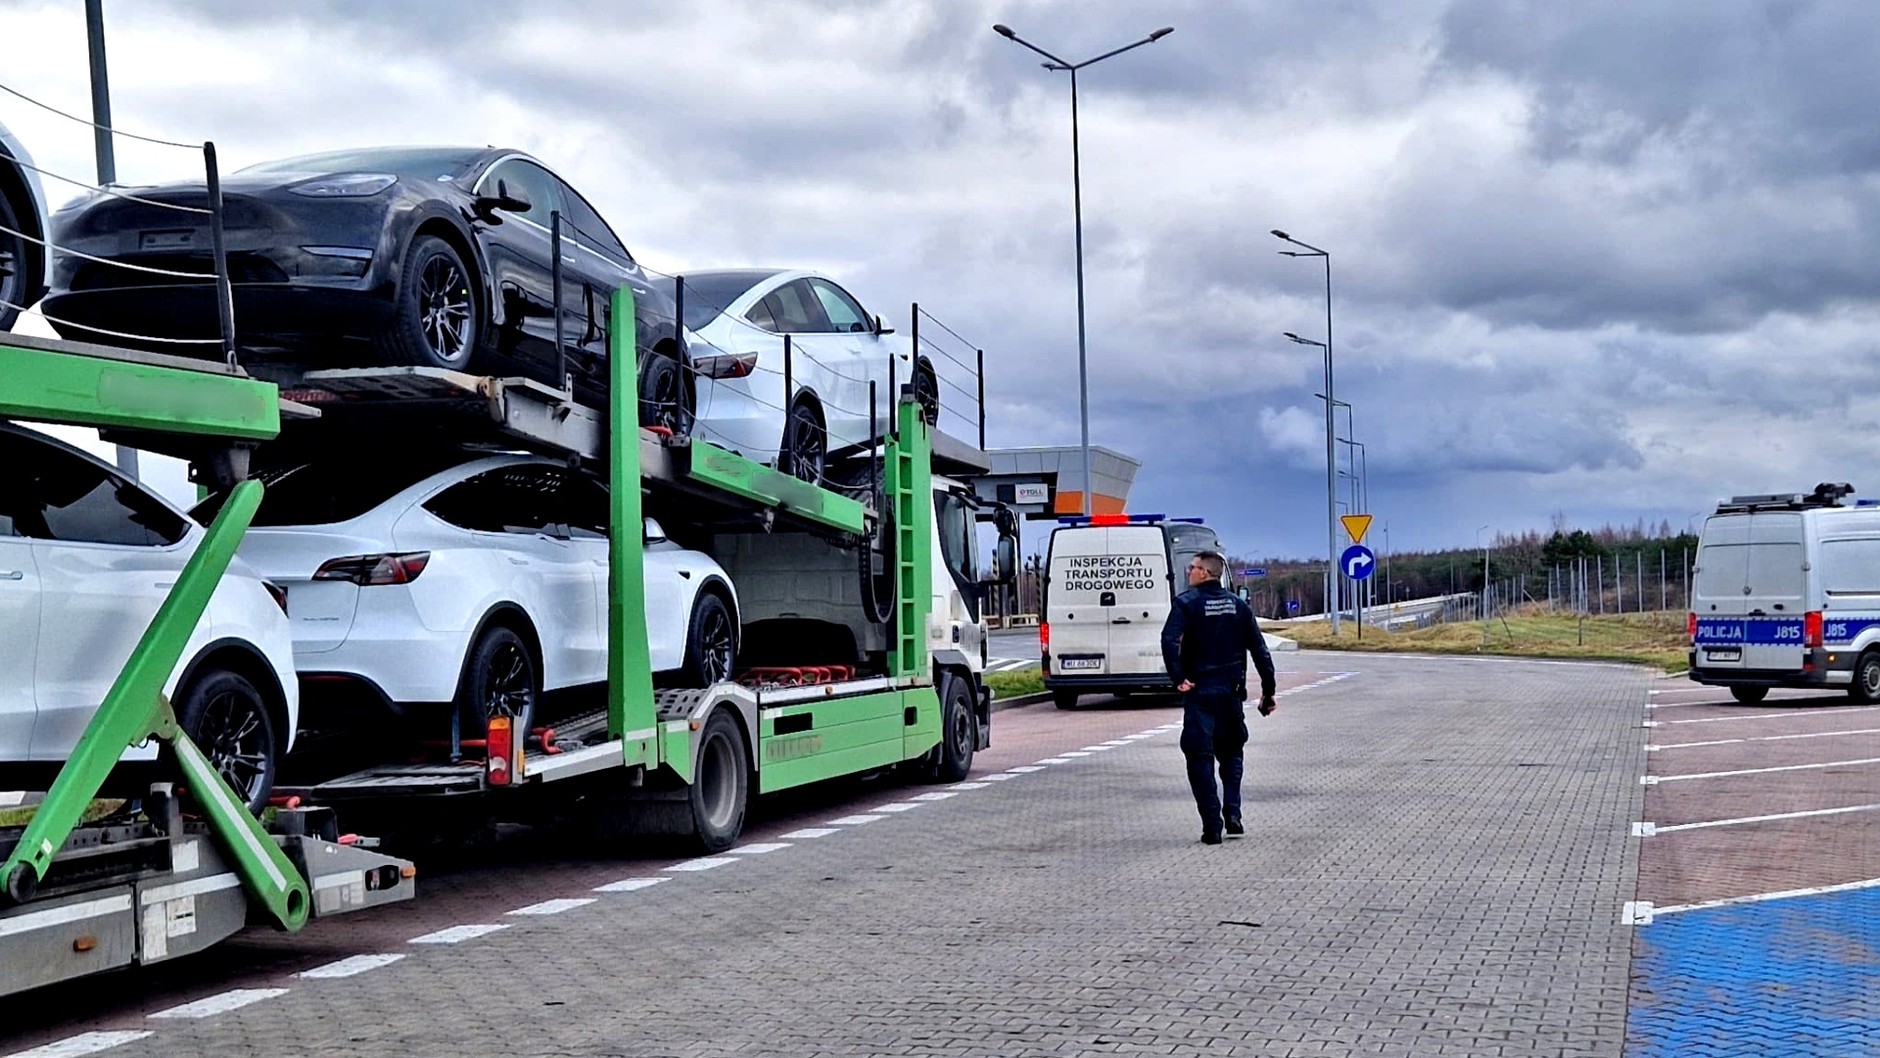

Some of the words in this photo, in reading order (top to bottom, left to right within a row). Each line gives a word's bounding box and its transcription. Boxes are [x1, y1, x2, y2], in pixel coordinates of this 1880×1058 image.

[1070, 557, 1143, 568] INSPEKCJA
[1065, 568, 1153, 579] TRANSPORTU
[1065, 580, 1155, 591] DROGOWEGO
[1697, 626, 1742, 638] POLICJA
[1774, 626, 1801, 639] J815
[1825, 623, 1847, 637] J815
